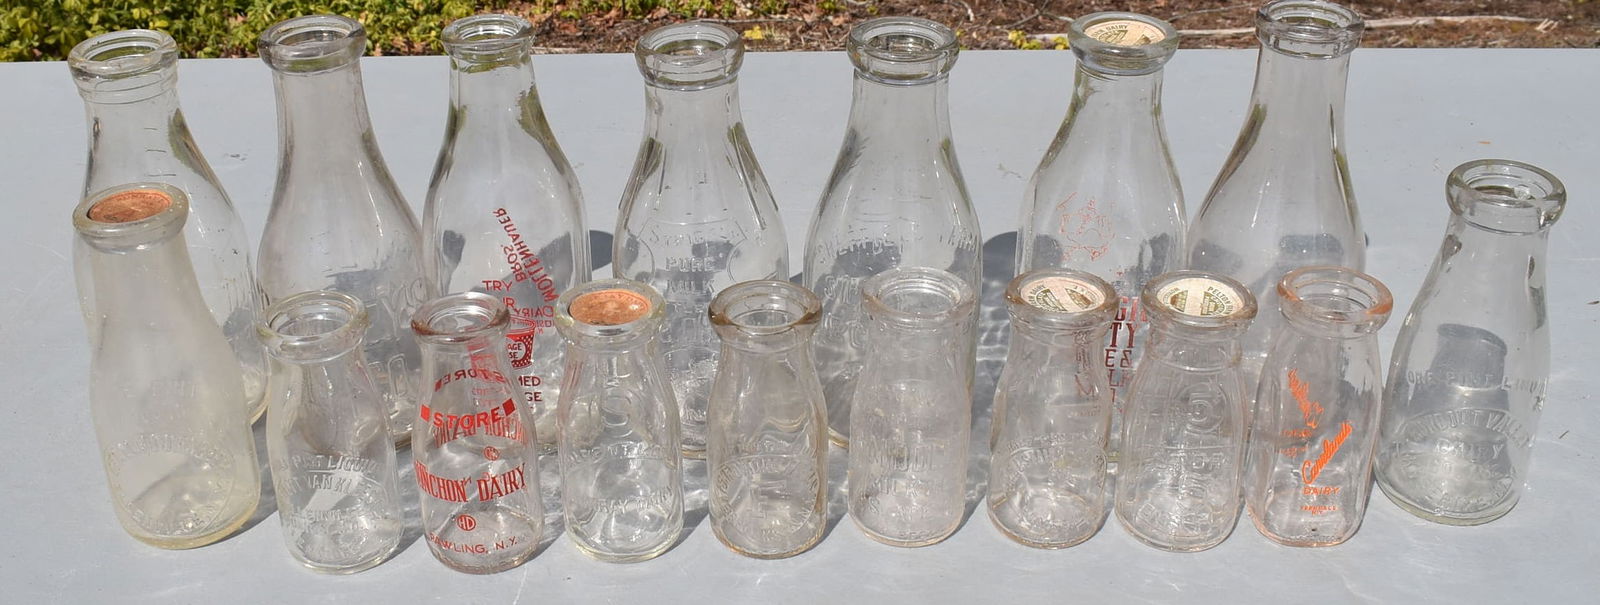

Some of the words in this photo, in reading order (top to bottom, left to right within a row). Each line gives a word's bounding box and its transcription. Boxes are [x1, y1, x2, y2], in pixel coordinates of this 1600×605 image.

[482, 280, 513, 292] TRY
[433, 406, 501, 430] STORE
[476, 462, 526, 502] DAIRY
[1303, 486, 1341, 496] DAIRY
